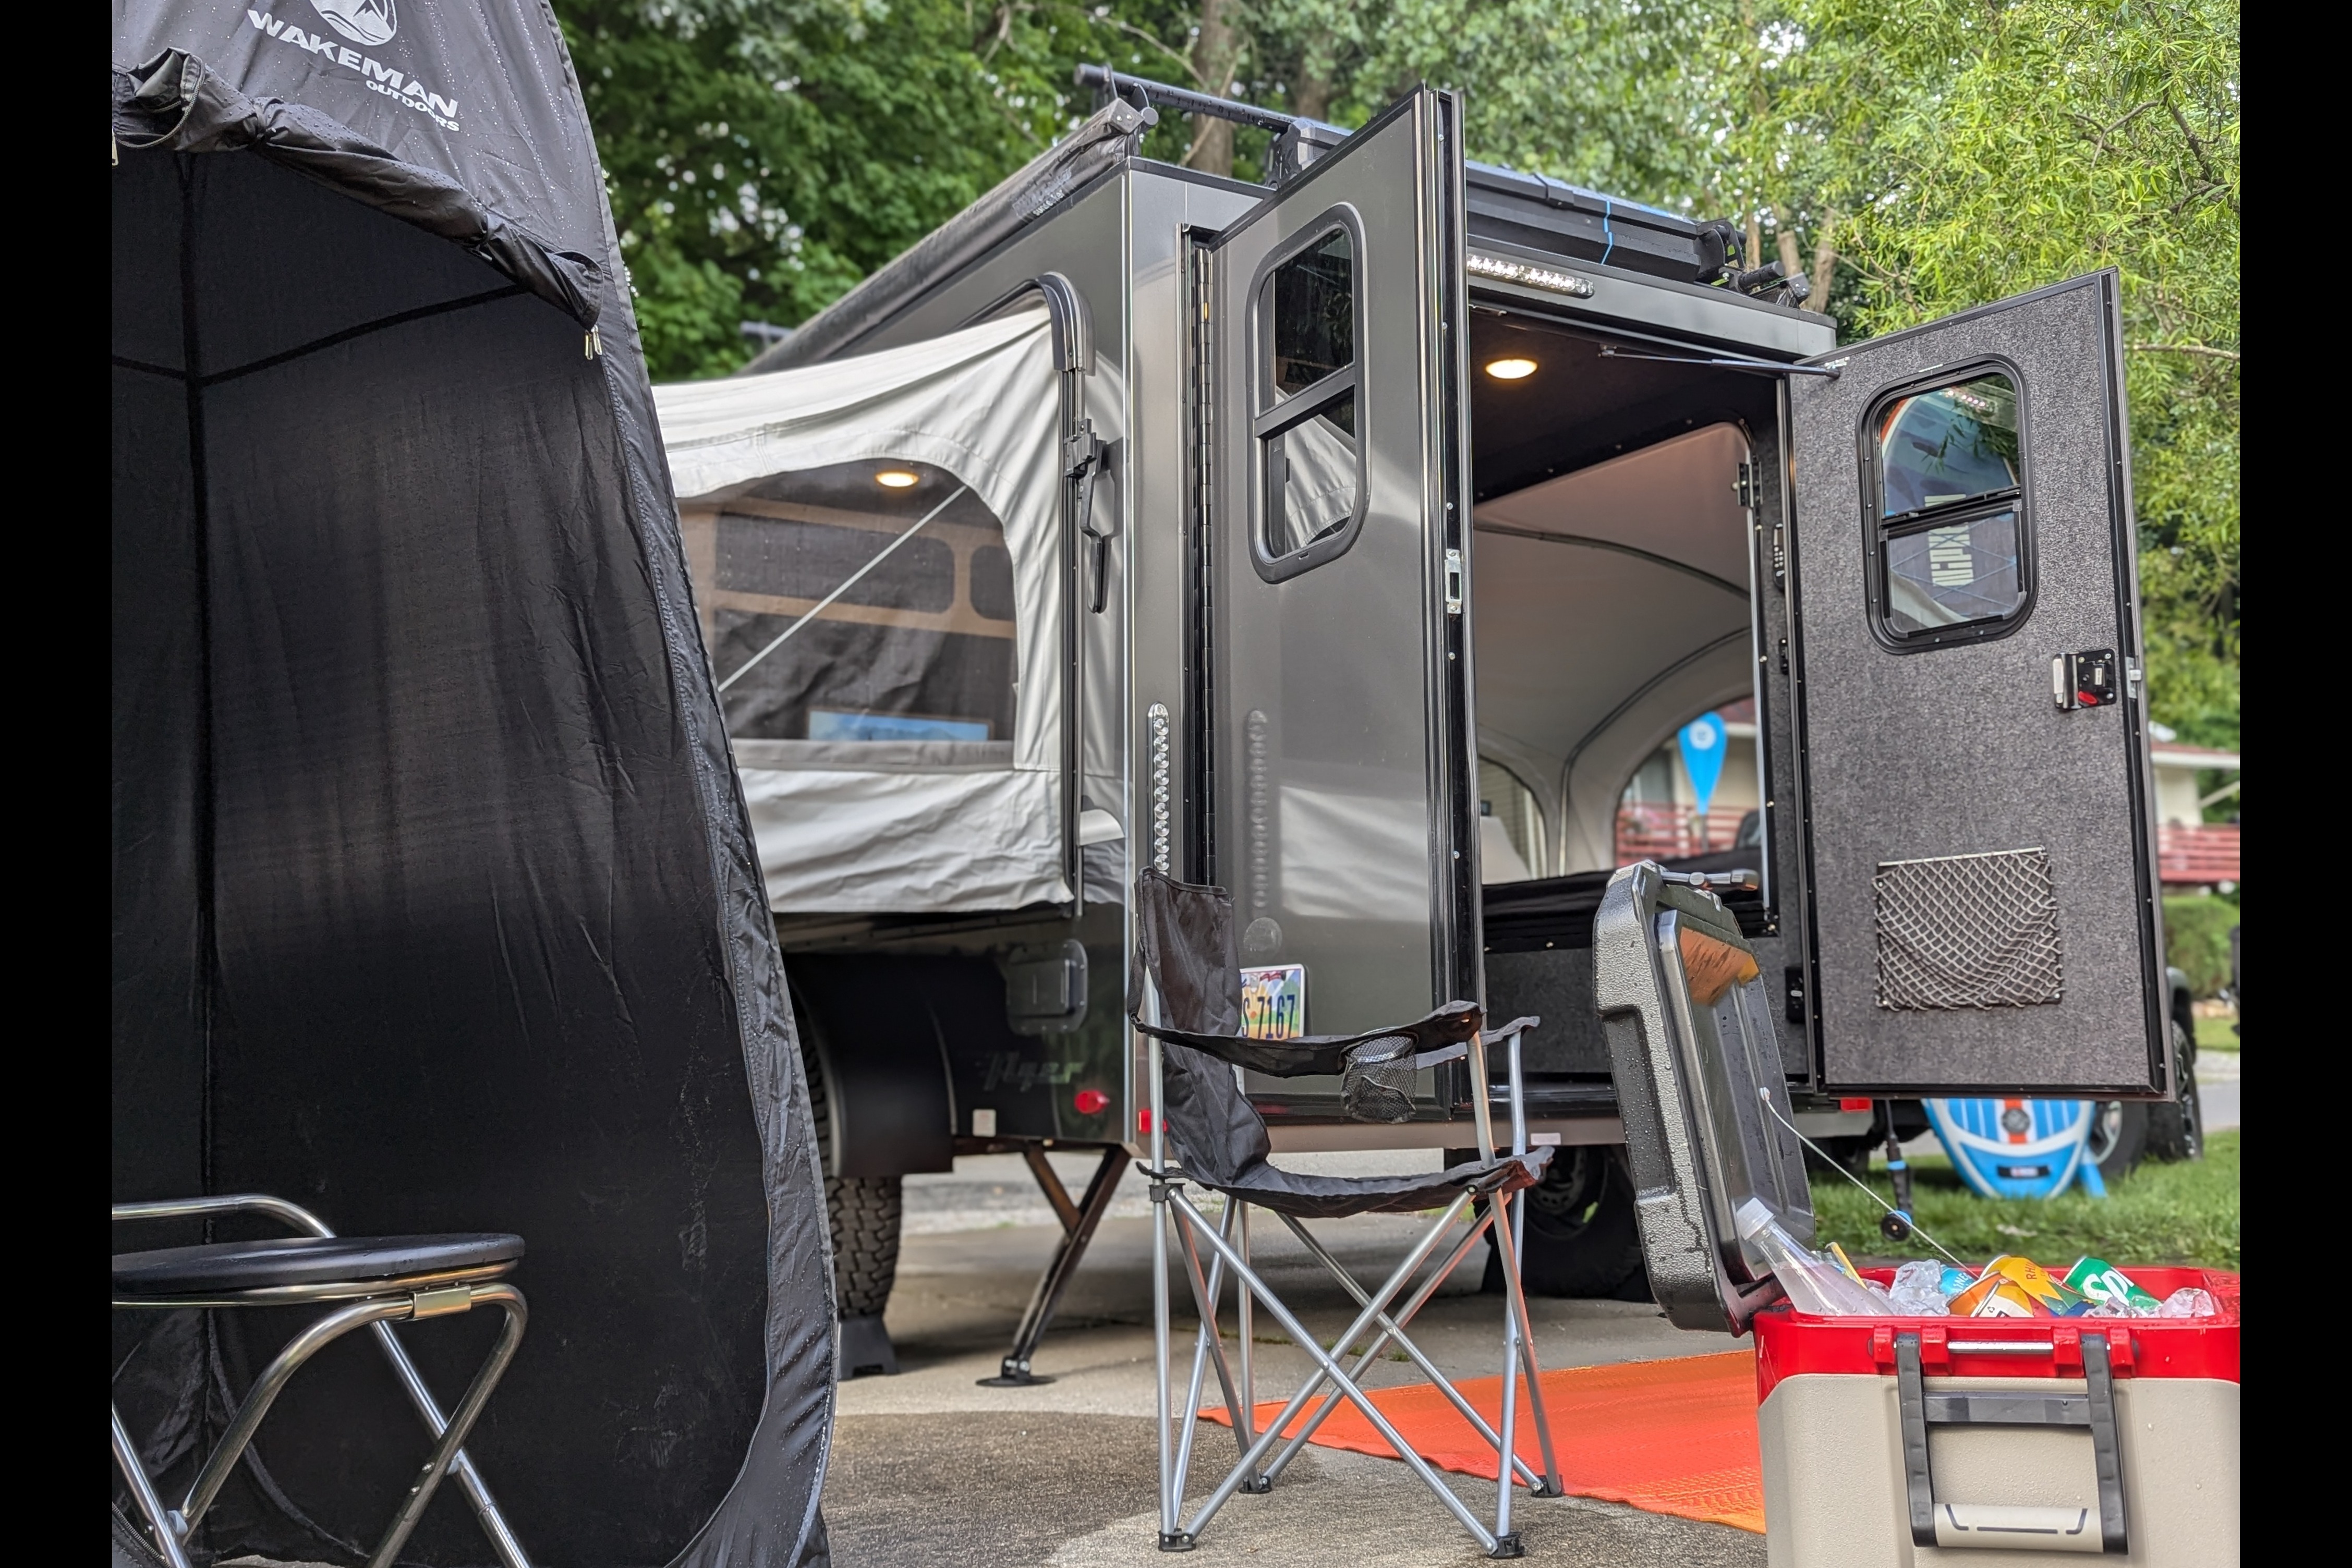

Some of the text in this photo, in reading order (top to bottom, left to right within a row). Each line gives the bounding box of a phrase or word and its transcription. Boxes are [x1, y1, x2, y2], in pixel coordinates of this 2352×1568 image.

[247, 9, 459, 118] WAKEMAN
[366, 80, 460, 132] OUTDOORS
[1257, 994, 1295, 1039] 7167
